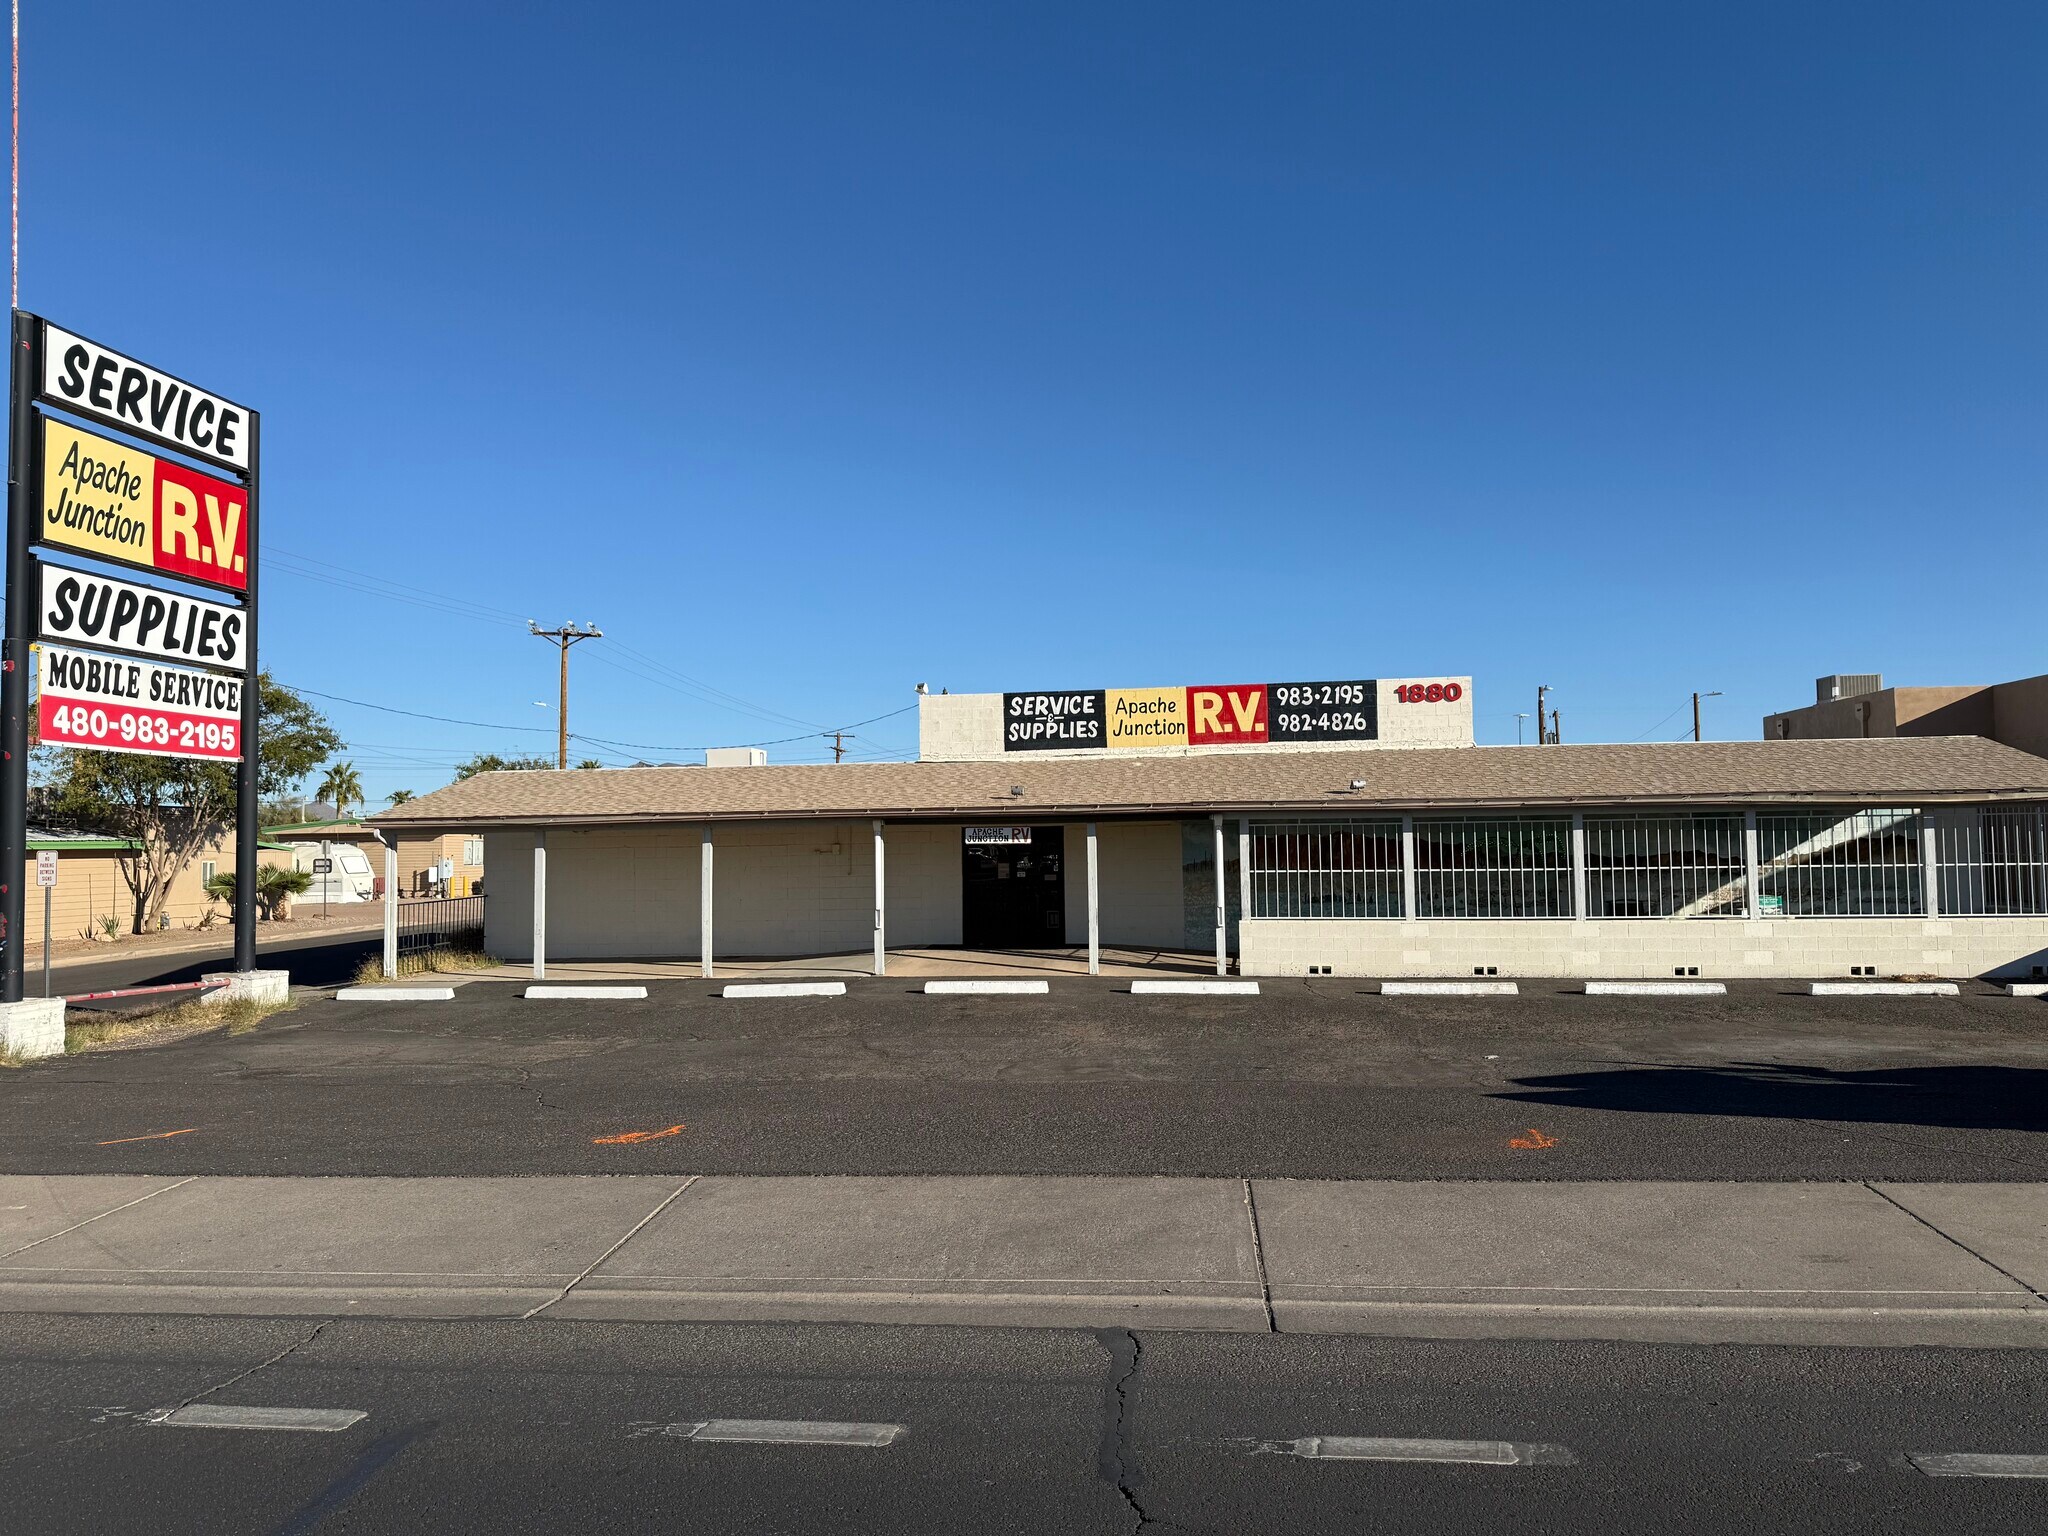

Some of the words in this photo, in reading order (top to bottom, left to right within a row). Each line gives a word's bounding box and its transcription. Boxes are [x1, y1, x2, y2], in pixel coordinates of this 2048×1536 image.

[58, 344, 240, 456] SERVICE
[58, 440, 142, 501] Apache
[48, 488, 145, 548] Junction
[161, 479, 244, 573] R.V.
[49, 576, 240, 662] SUPPLIES
[49, 652, 141, 699] MOBILE
[150, 669, 239, 712] SERVICE
[1394, 682, 1462, 703] 1880
[1009, 695, 1095, 716] SERVICE
[1115, 697, 1177, 718] Apache
[1193, 691, 1265, 734] R.V.
[52, 705, 236, 751] 480-983-2195
[1008, 720, 1099, 741] SUPPLIES
[1113, 719, 1185, 736] Junction
[972, 828, 1004, 836] APACHE
[1012, 828, 1029, 842] RV
